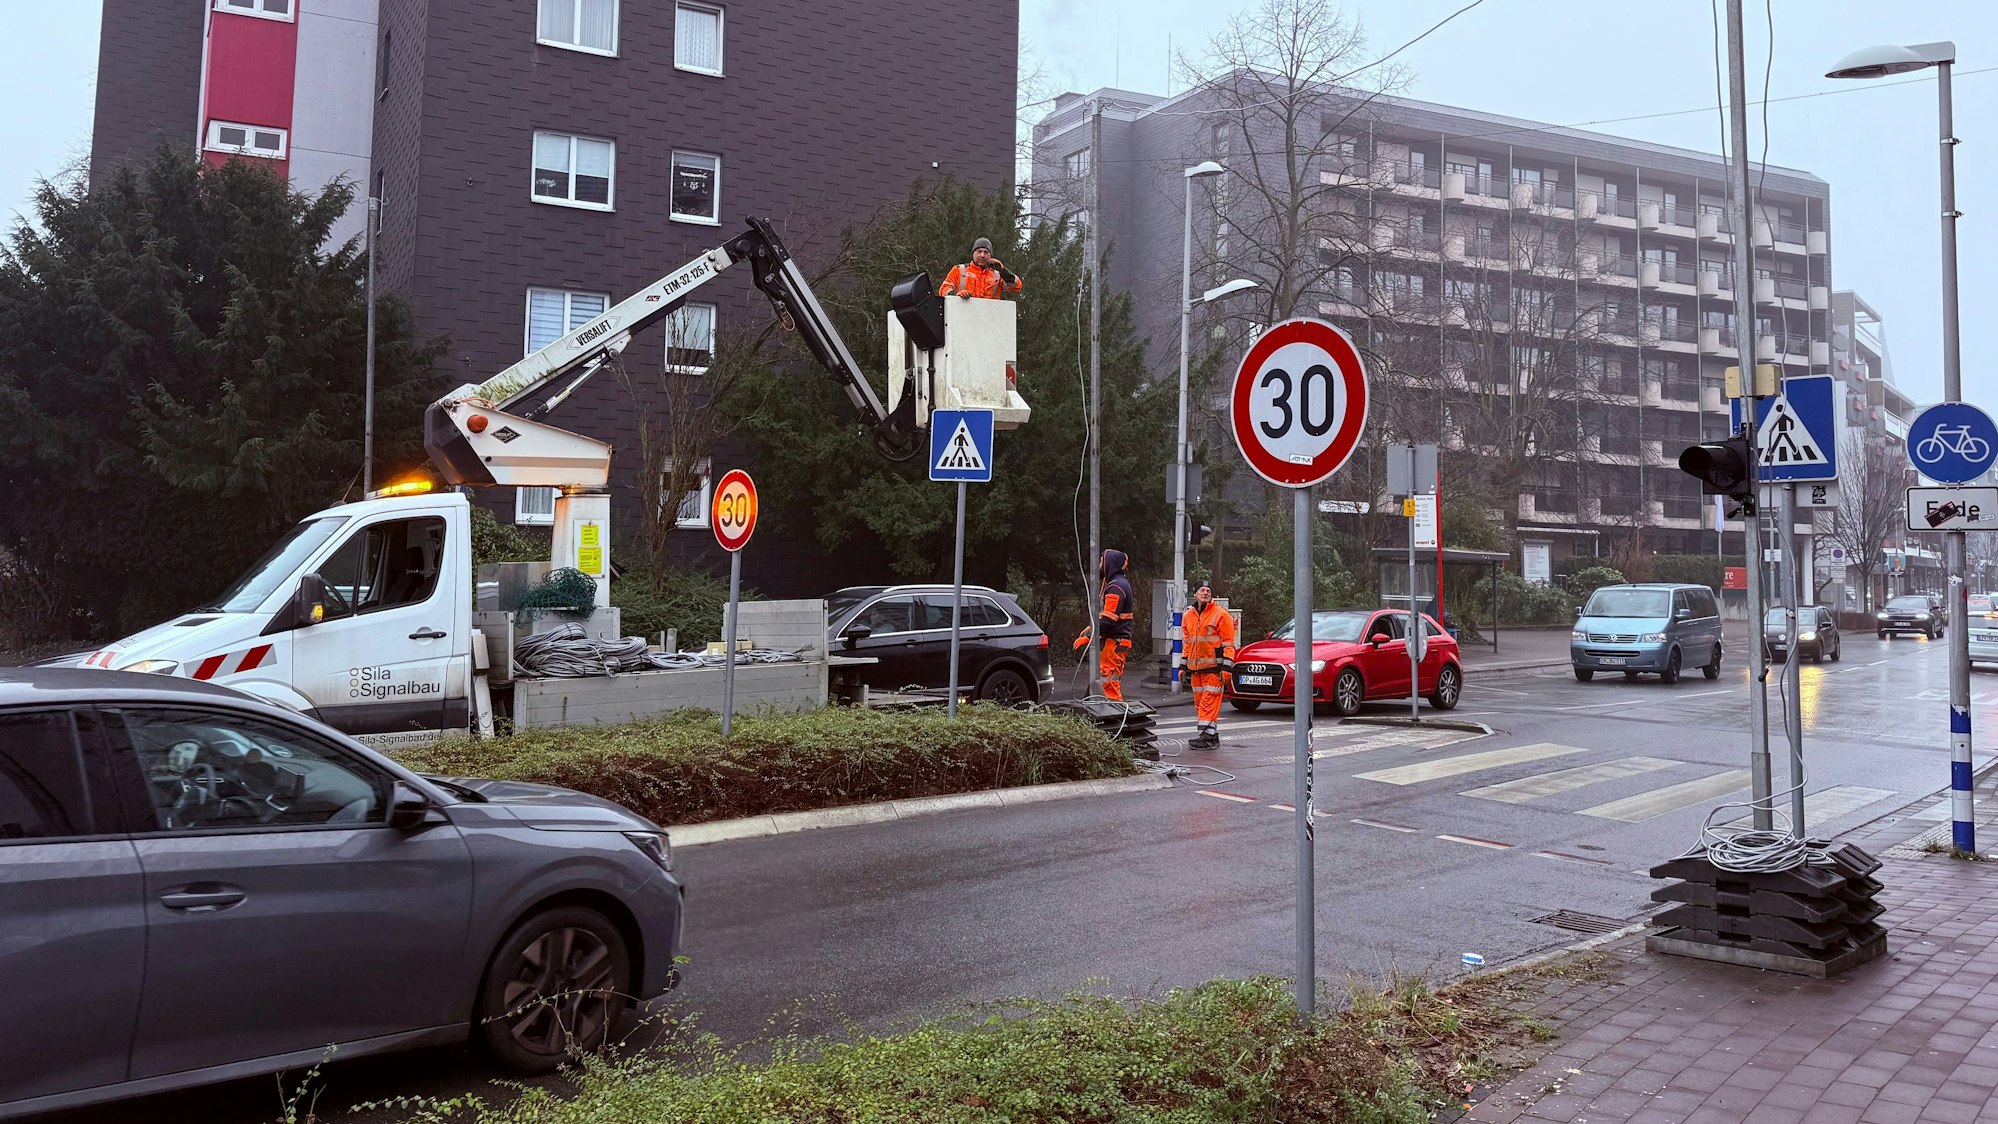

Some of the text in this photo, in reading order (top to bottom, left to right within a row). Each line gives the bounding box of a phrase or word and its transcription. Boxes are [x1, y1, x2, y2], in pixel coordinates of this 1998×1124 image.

[663, 261, 710, 295] ETM-32-125-F
[576, 319, 612, 347] VERSALIFT
[1260, 364, 1334, 439] 30
[721, 493, 747, 527] 30
[1926, 501, 1980, 517] Ede
[361, 667, 391, 681] Sila
[360, 681, 440, 699] Signalbau
